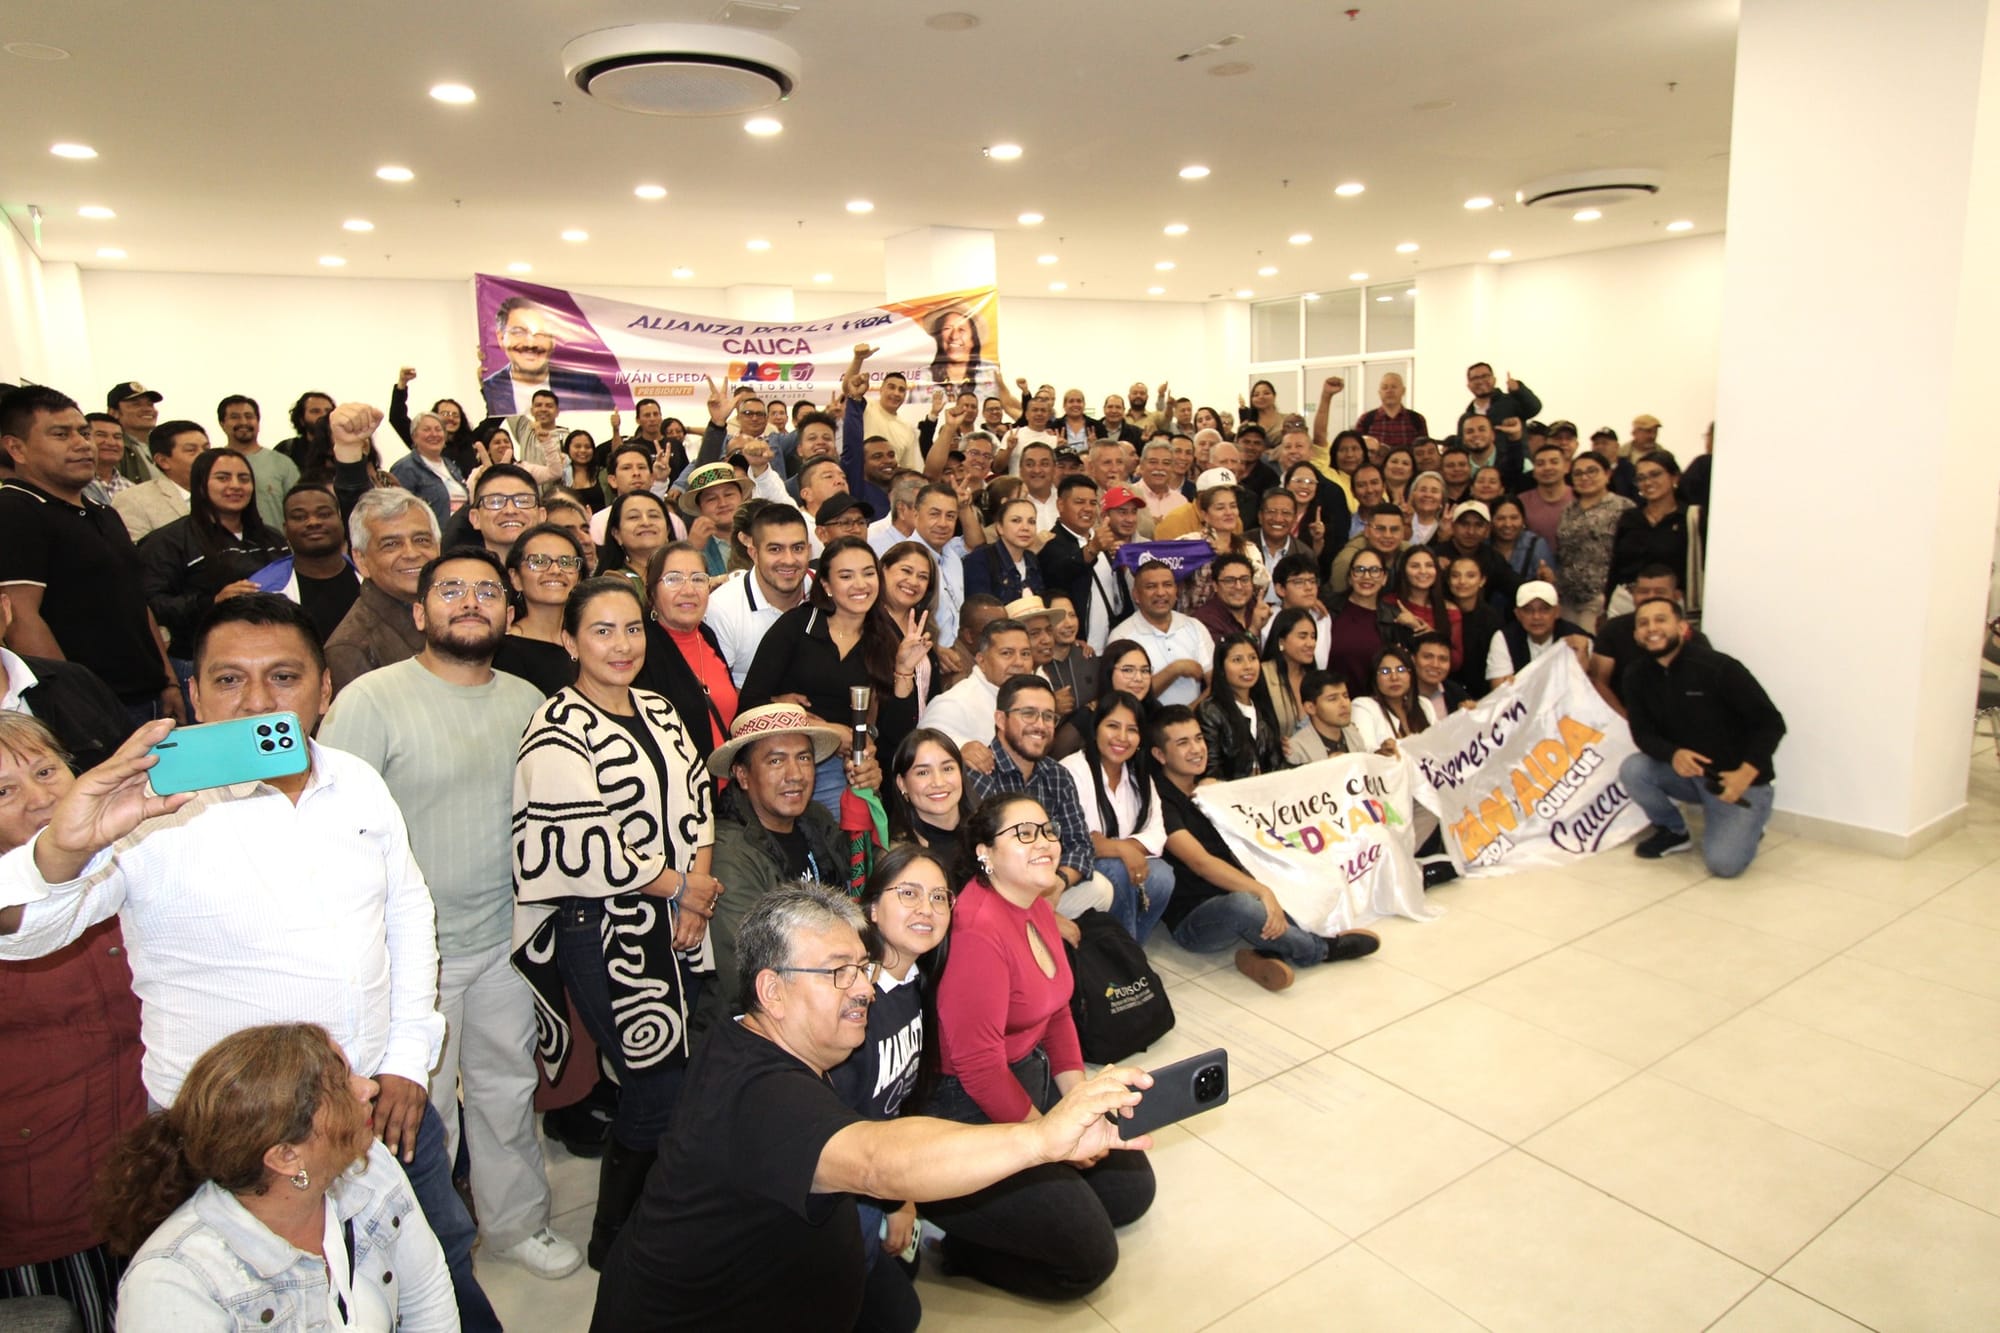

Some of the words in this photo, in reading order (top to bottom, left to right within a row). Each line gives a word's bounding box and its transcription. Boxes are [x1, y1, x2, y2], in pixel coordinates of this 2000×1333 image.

[627, 315, 744, 336] ALIANZA
[722, 338, 812, 355] CAUCA
[615, 369, 652, 385] IVÁN
[637, 386, 693, 396] PRESIDENTE
[1510, 716, 1605, 818] AIDA
[1348, 799, 1403, 834] AIDA
[1550, 782, 1629, 854] Cauca
[1340, 843, 1382, 879] uca
